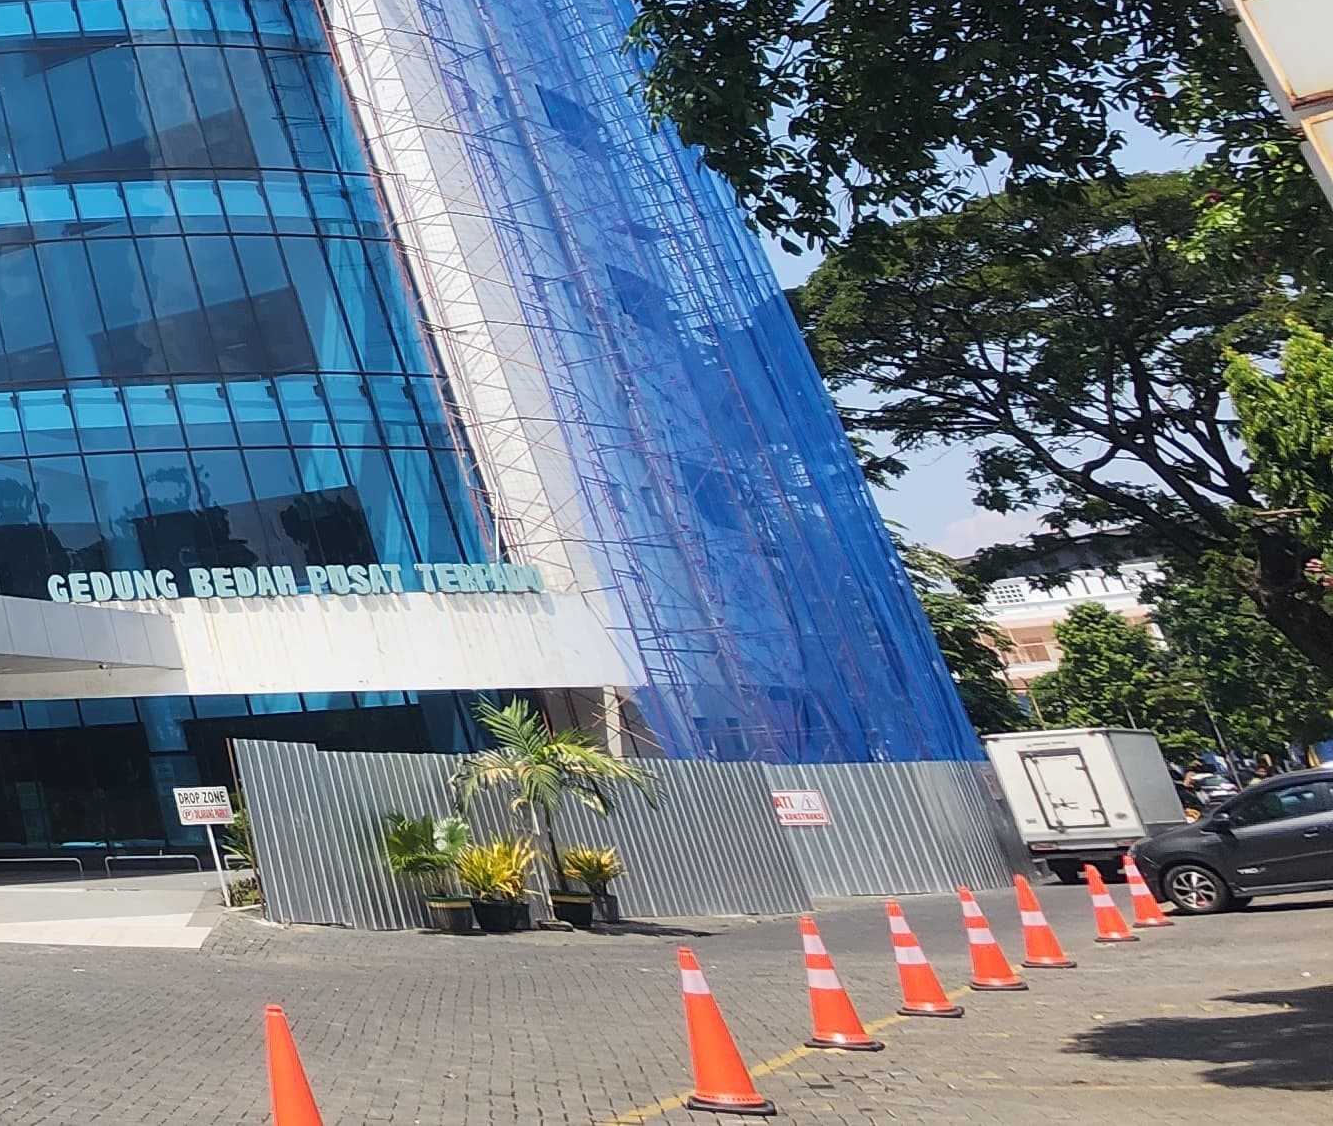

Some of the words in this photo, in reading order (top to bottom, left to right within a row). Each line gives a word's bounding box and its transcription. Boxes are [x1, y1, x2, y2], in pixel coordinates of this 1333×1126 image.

[48, 568, 178, 604] GEDUNG
[193, 565, 298, 600] BEDAH
[306, 564, 404, 596] PUSAT
[178, 791, 200, 804] DROP
[202, 790, 226, 803] ZONE
